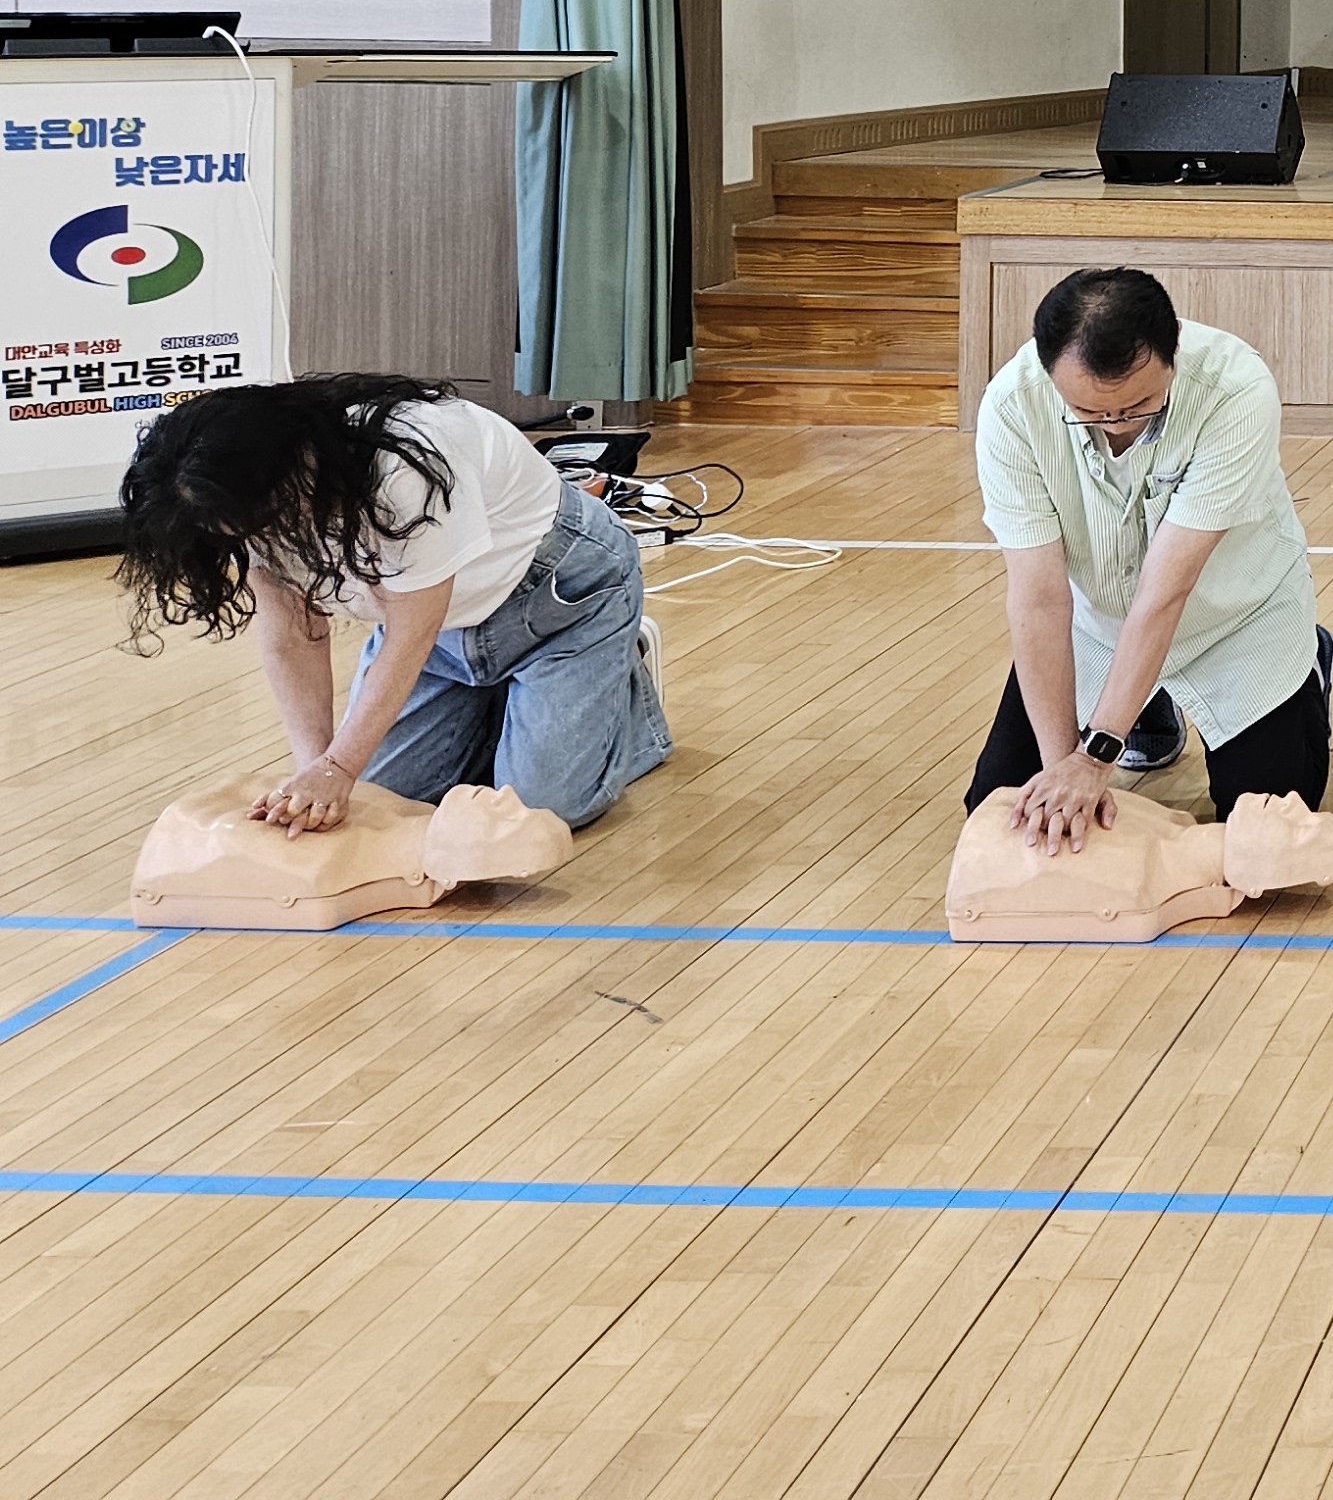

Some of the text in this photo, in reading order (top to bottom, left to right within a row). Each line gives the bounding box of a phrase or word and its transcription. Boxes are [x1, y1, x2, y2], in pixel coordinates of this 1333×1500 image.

[3, 117, 146, 150] 높은이상
[115, 153, 246, 187] 낮은자세
[5, 339, 122, 361] 대안교육 특성화
[161, 333, 239, 350] SINCE 2004
[1, 353, 243, 399] 달구벌고등학교
[10, 398, 112, 421] DALGUBUL
[113, 394, 162, 411] HIGH
